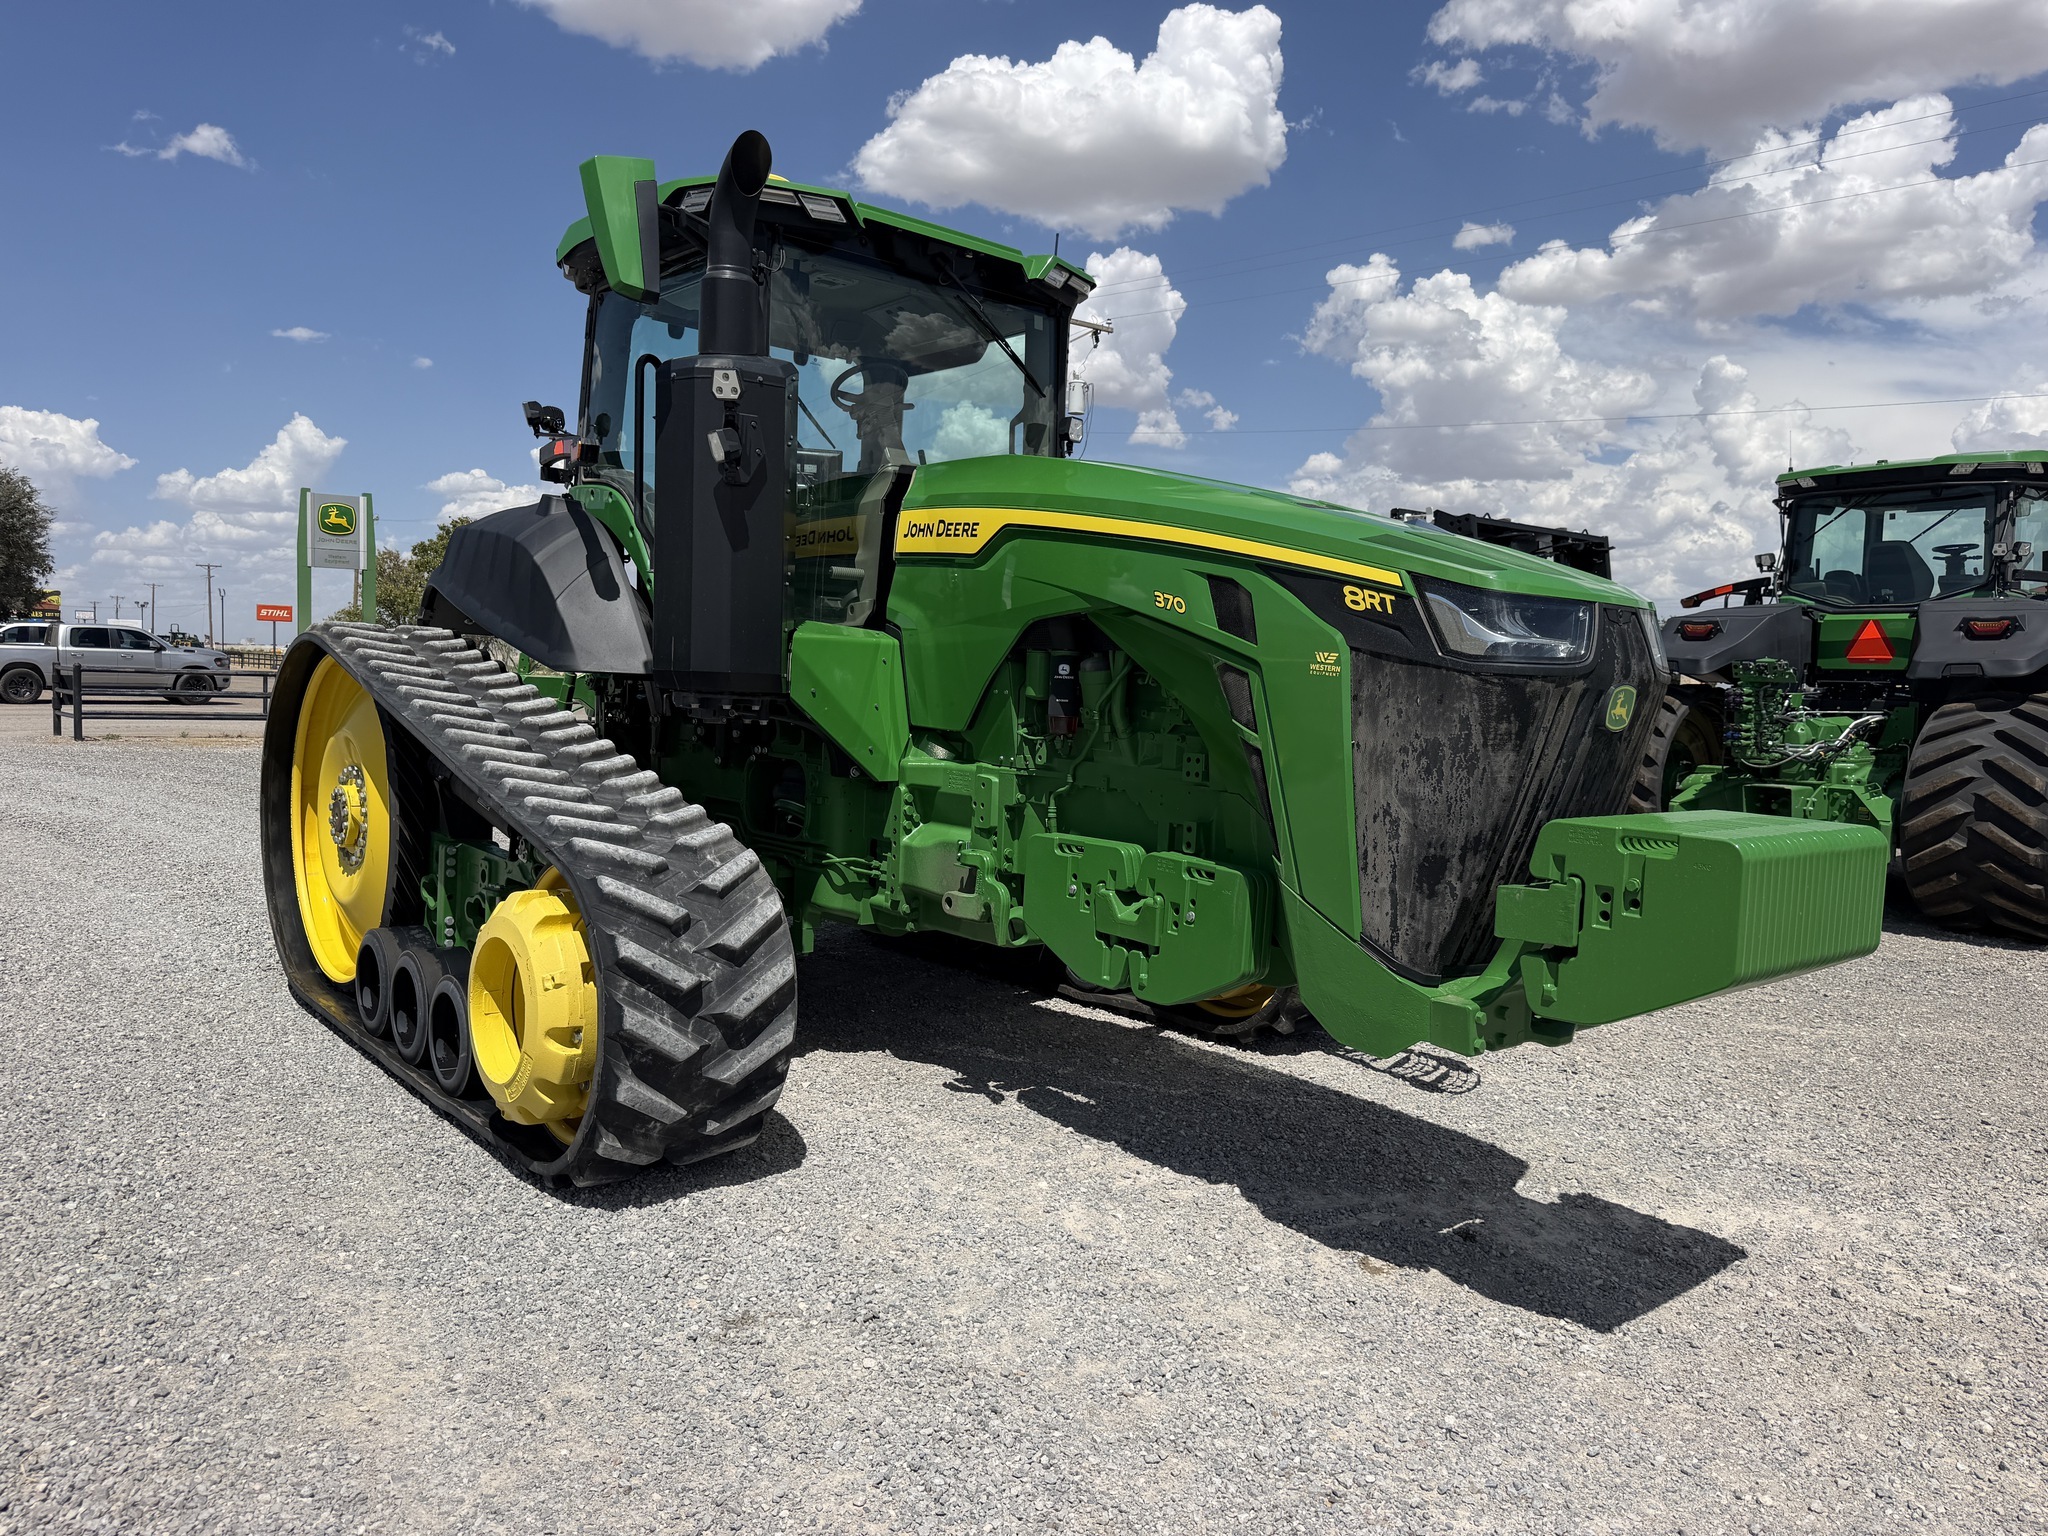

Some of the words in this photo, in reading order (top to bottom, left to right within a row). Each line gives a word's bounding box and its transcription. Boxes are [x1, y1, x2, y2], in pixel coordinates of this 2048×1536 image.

[903, 520, 935, 539] JOHN
[936, 519, 980, 538] DEERE
[1153, 590, 1186, 615] 370
[1343, 585, 1396, 615] 8RT
[259, 609, 291, 617] STIHL
[1309, 664, 1341, 673] WESTERN
